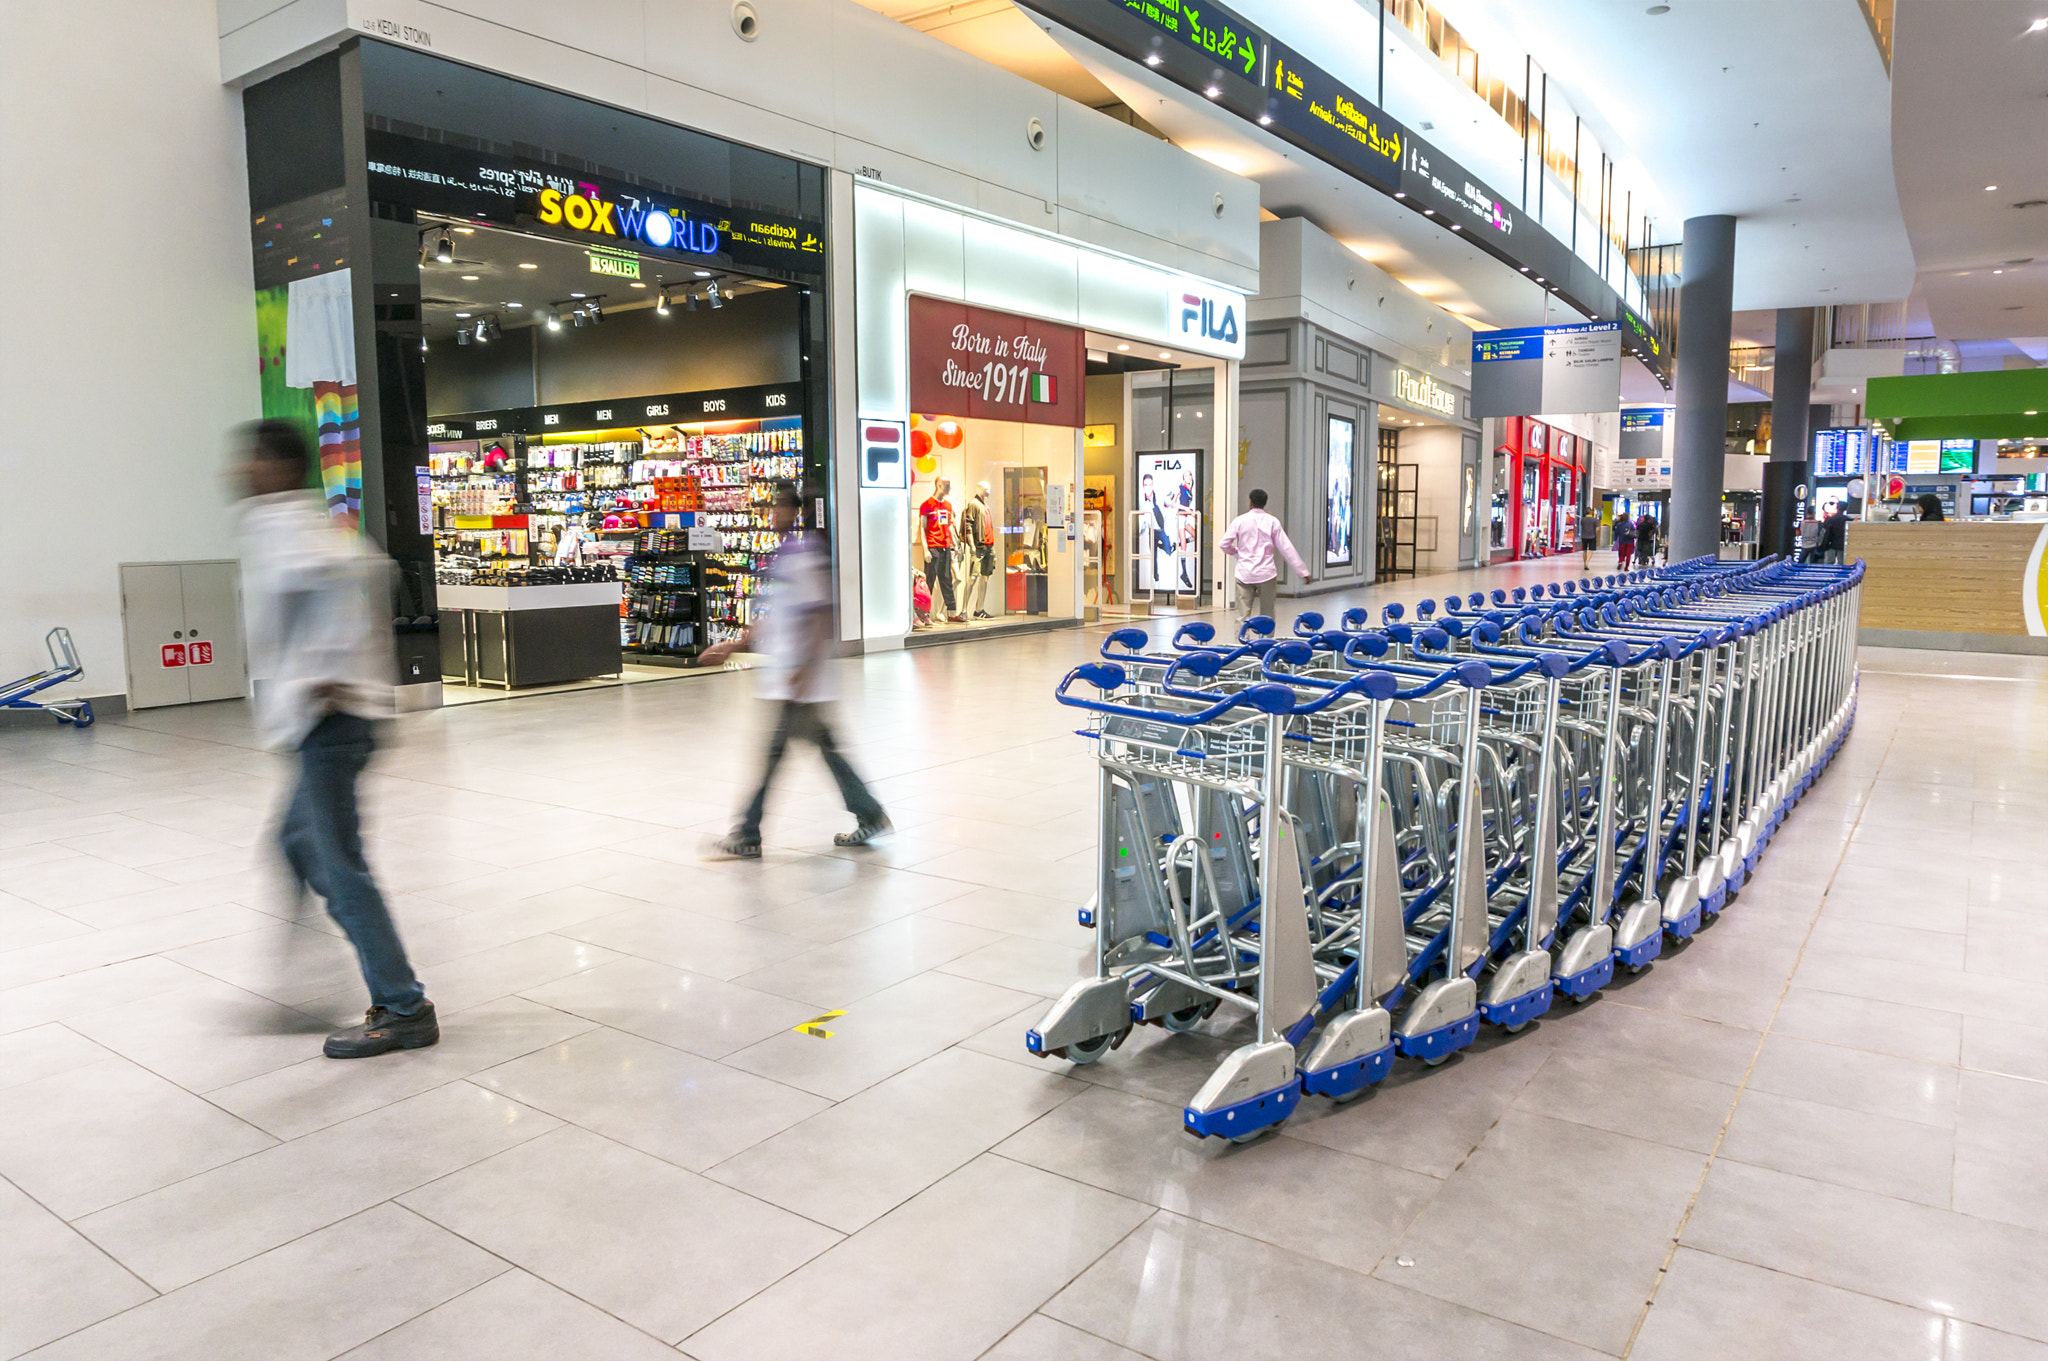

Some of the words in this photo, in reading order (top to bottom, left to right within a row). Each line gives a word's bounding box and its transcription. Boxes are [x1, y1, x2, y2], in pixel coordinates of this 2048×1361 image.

[377, 19, 400, 38] KEDAI
[403, 25, 431, 47] STOKIN
[1336, 94, 1368, 130] Ketibaan
[540, 189, 617, 236] SOX
[616, 204, 718, 254] WORLD
[1182, 293, 1238, 345] FILA
[1589, 323, 1611, 332] Level
[951, 324, 992, 355] Born
[994, 335, 1010, 357] in
[1013, 335, 1047, 371] Italy
[942, 358, 983, 390] Since
[982, 361, 1029, 405] 1911
[646, 404, 669, 417] GIRLS
[703, 399, 726, 412] BOYS
[765, 394, 786, 407] KIDS
[476, 419, 498, 431] BRIEFS
[1155, 460, 1182, 470] FILA
